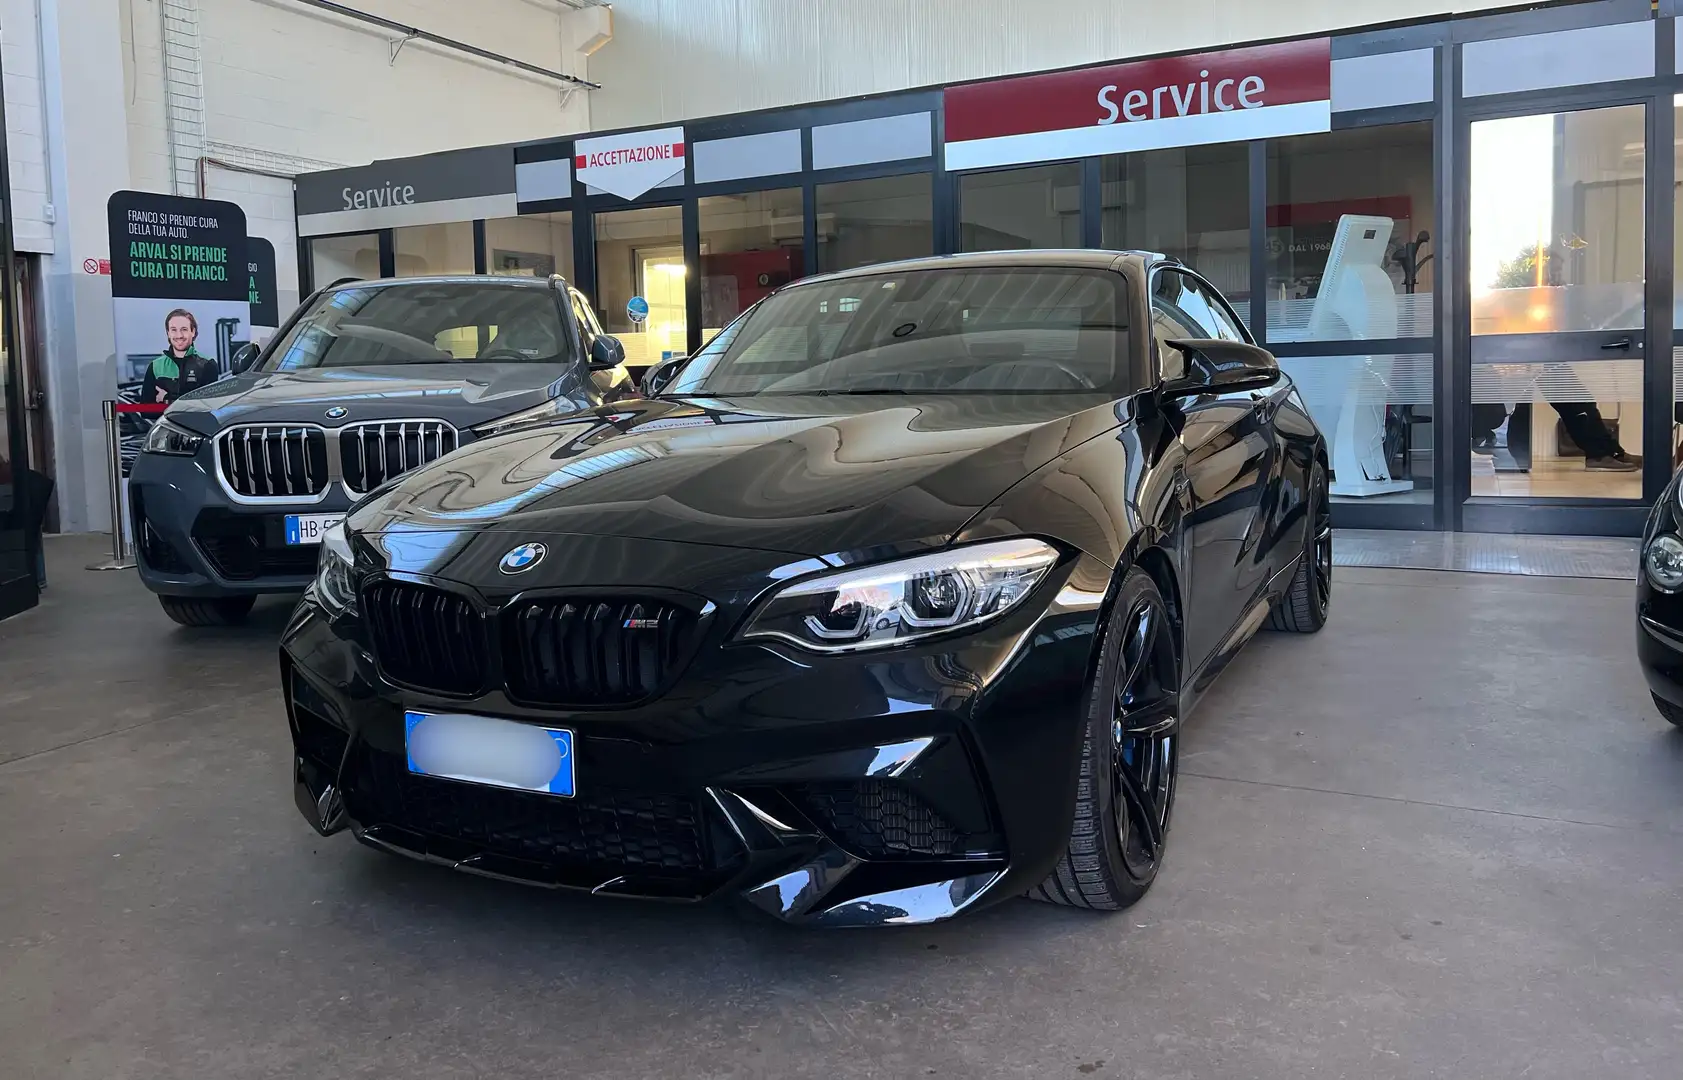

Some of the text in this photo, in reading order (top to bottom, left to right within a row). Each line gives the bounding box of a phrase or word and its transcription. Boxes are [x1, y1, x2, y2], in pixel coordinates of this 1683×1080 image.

[1097, 69, 1265, 125] Service
[589, 144, 671, 168] ACCETTAZIONE
[342, 181, 415, 211] Service
[127, 209, 219, 228] FRANCO SI PRENDE CURA
[128, 222, 189, 239] DELLA TUA AUTO.
[129, 241, 227, 263] ARVAL SI PRENDE
[1288, 243, 1331, 252] DAL 1968
[130, 260, 164, 279] CURA
[166, 262, 178, 280] DI
[180, 264, 228, 282] FRANCO.
[300, 520, 318, 538] HB
[632, 619, 659, 628] M2
